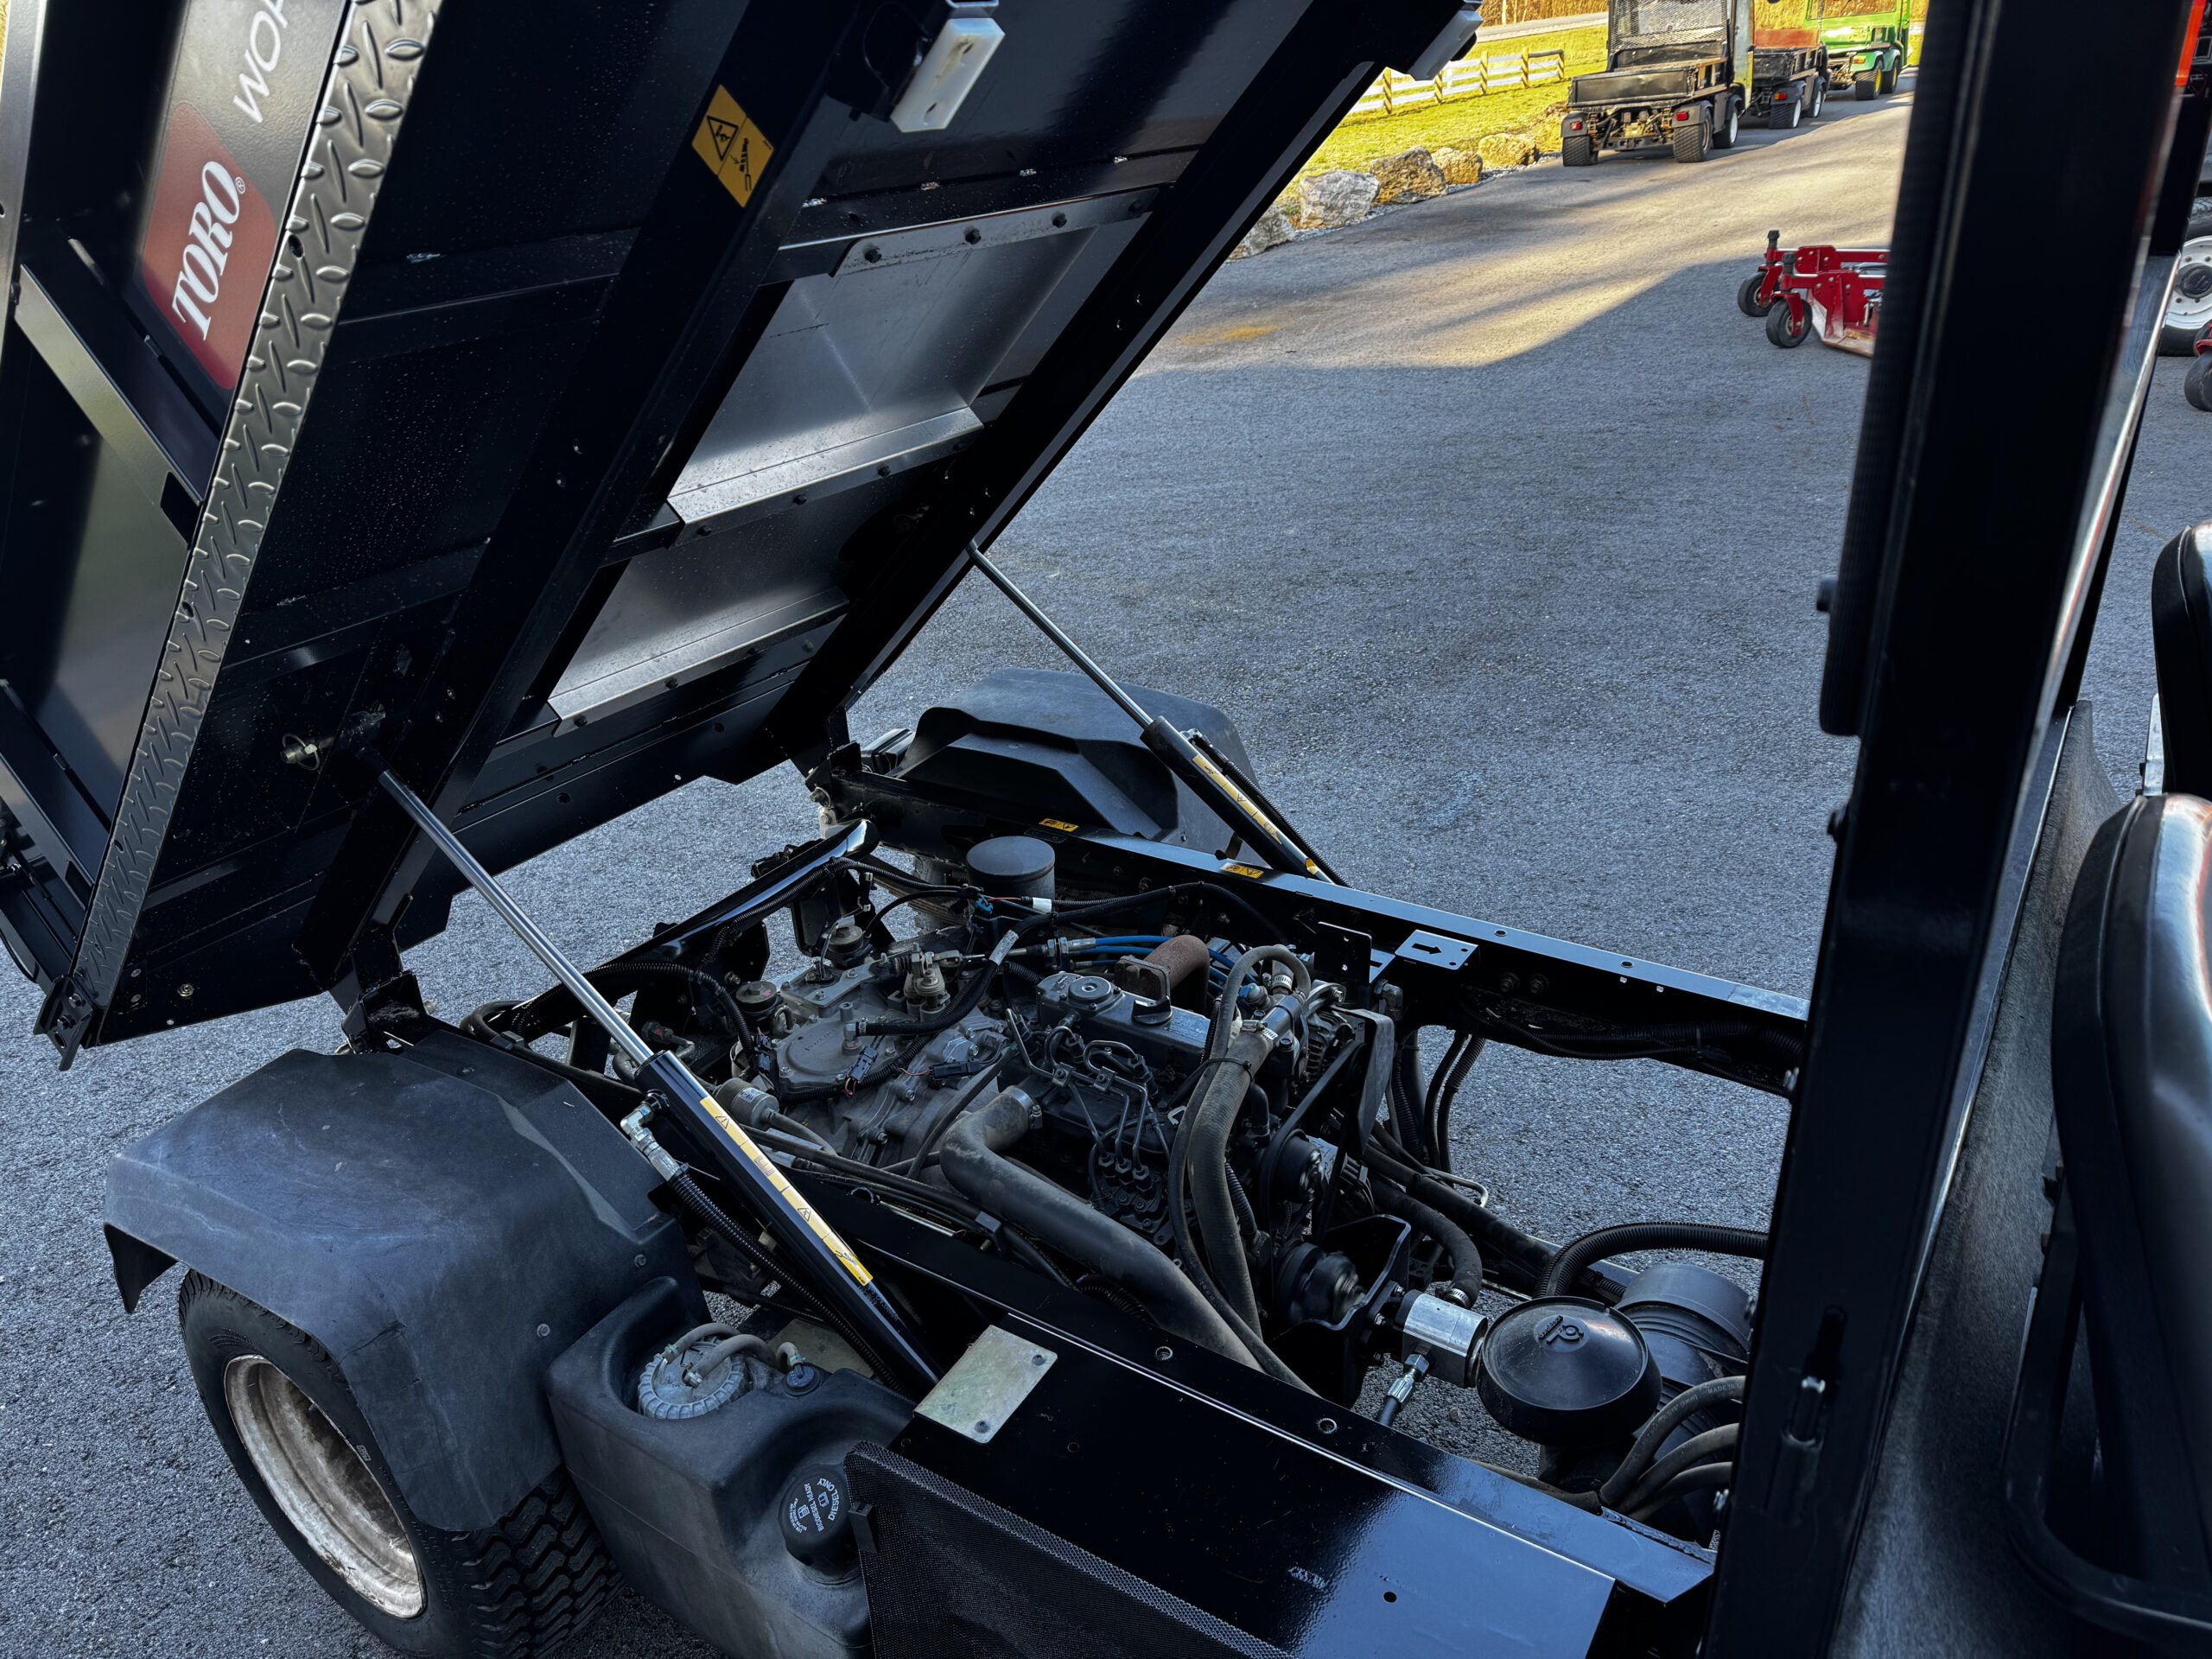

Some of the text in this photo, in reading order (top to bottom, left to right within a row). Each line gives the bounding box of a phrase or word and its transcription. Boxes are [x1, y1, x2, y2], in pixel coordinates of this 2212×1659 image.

[804, 1483, 824, 1531] BIODIESEL READY
[817, 1478, 840, 1521] DIESEL ONLY
